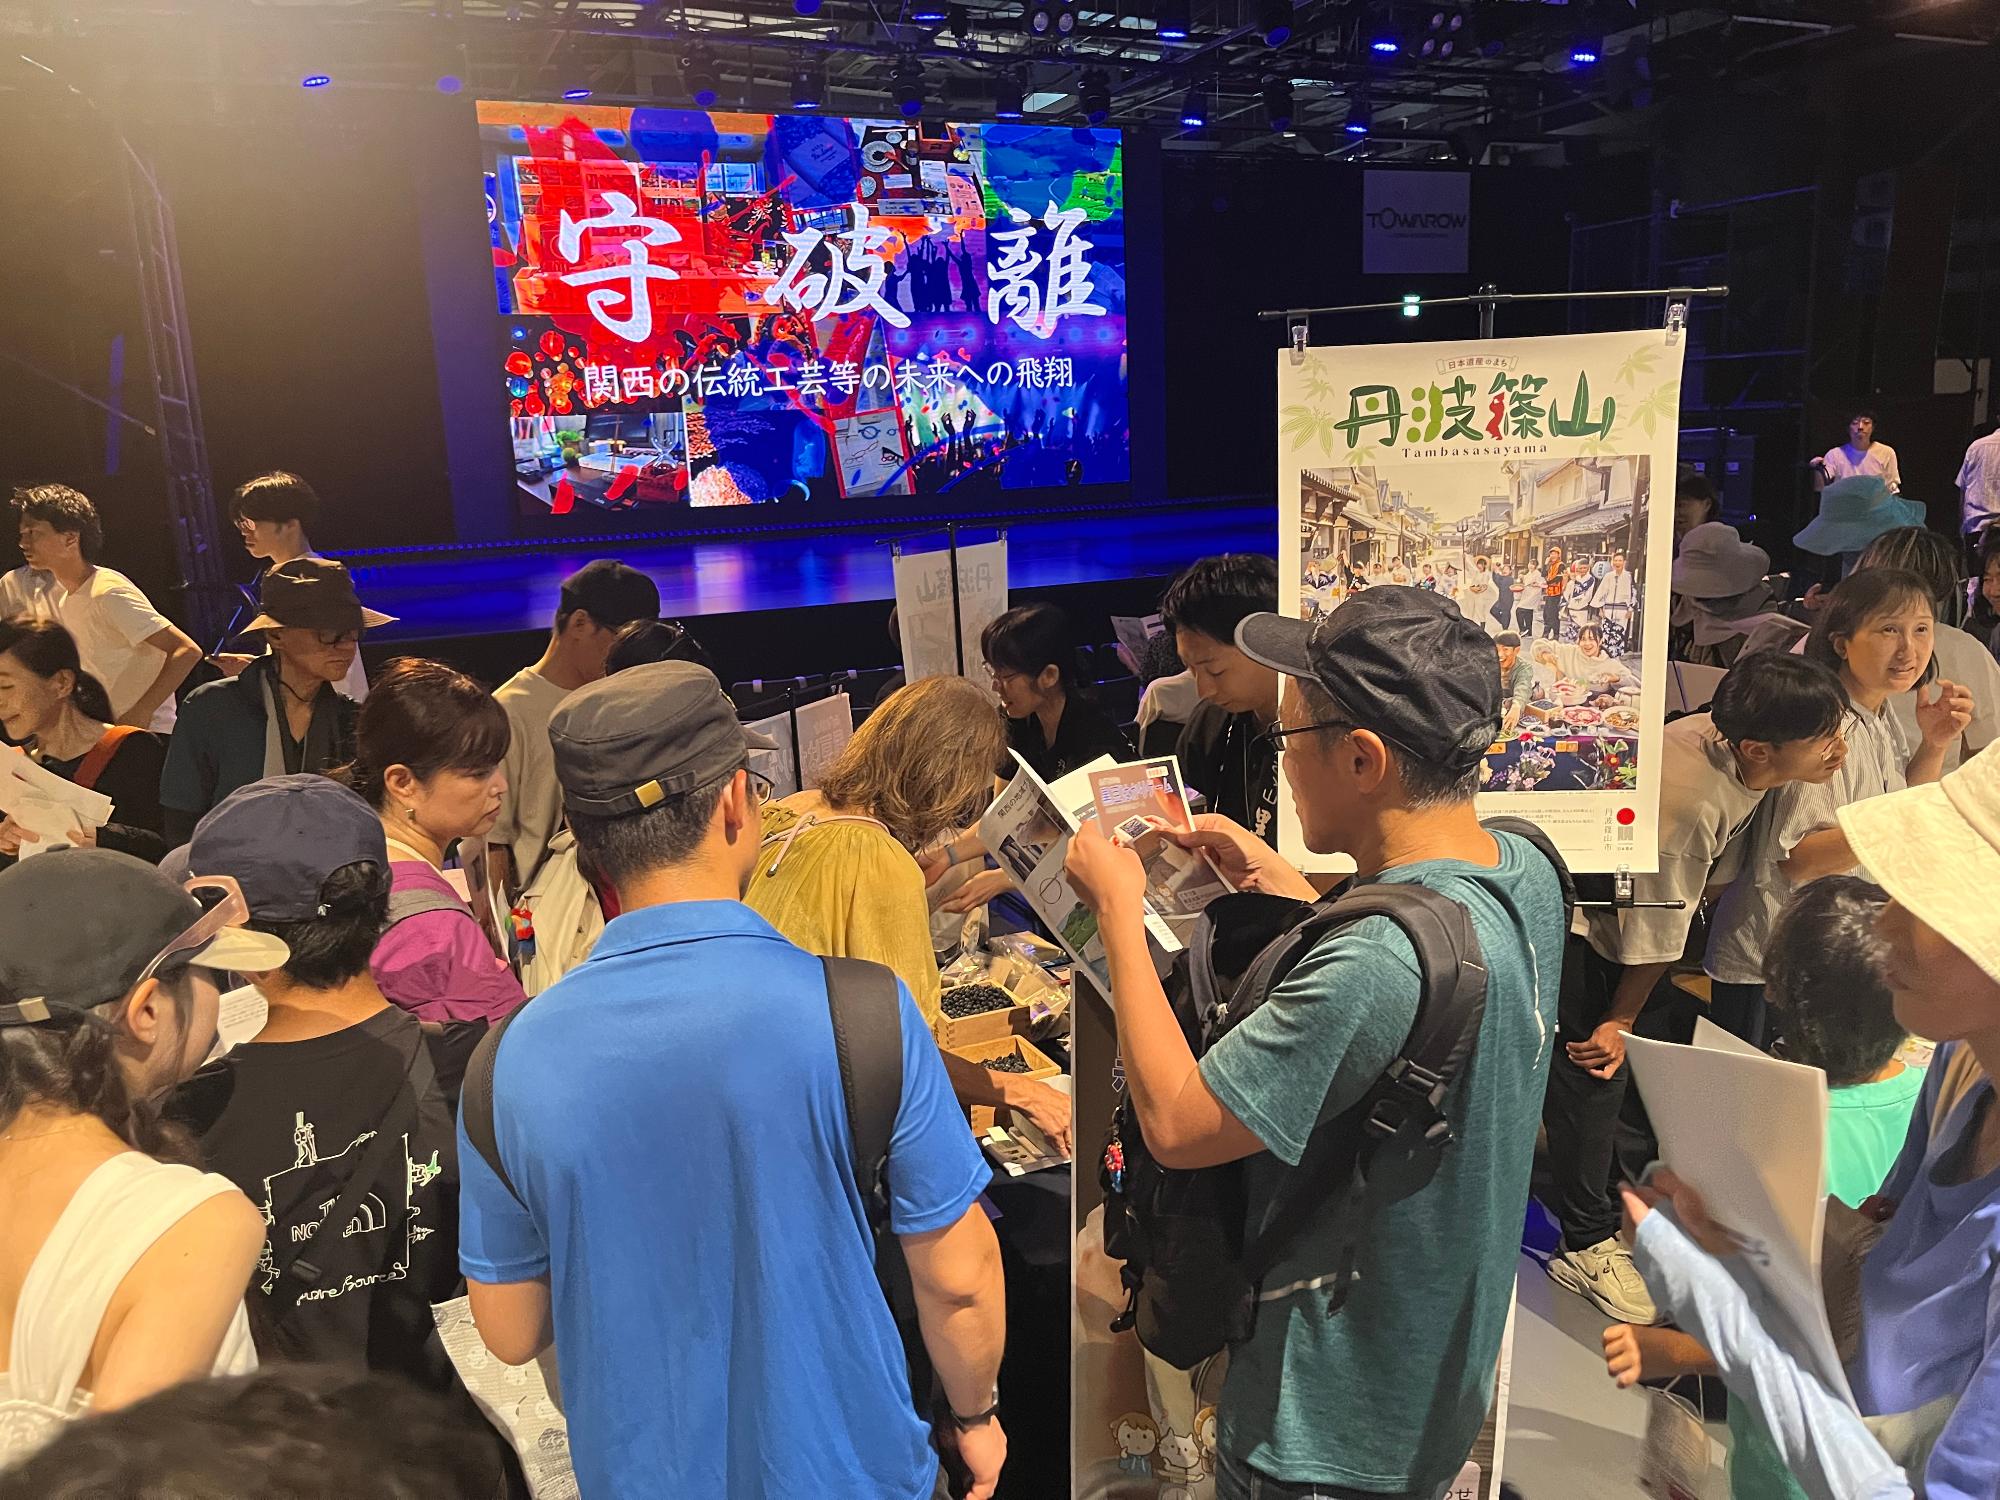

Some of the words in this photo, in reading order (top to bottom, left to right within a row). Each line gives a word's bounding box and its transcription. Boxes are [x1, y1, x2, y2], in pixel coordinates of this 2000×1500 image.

[584, 356, 1074, 401] 関西の伝統工芸等の未来への飛翔
[1334, 370, 1616, 448] 丹波篠山
[1401, 444, 1549, 459] Tambasasayama
